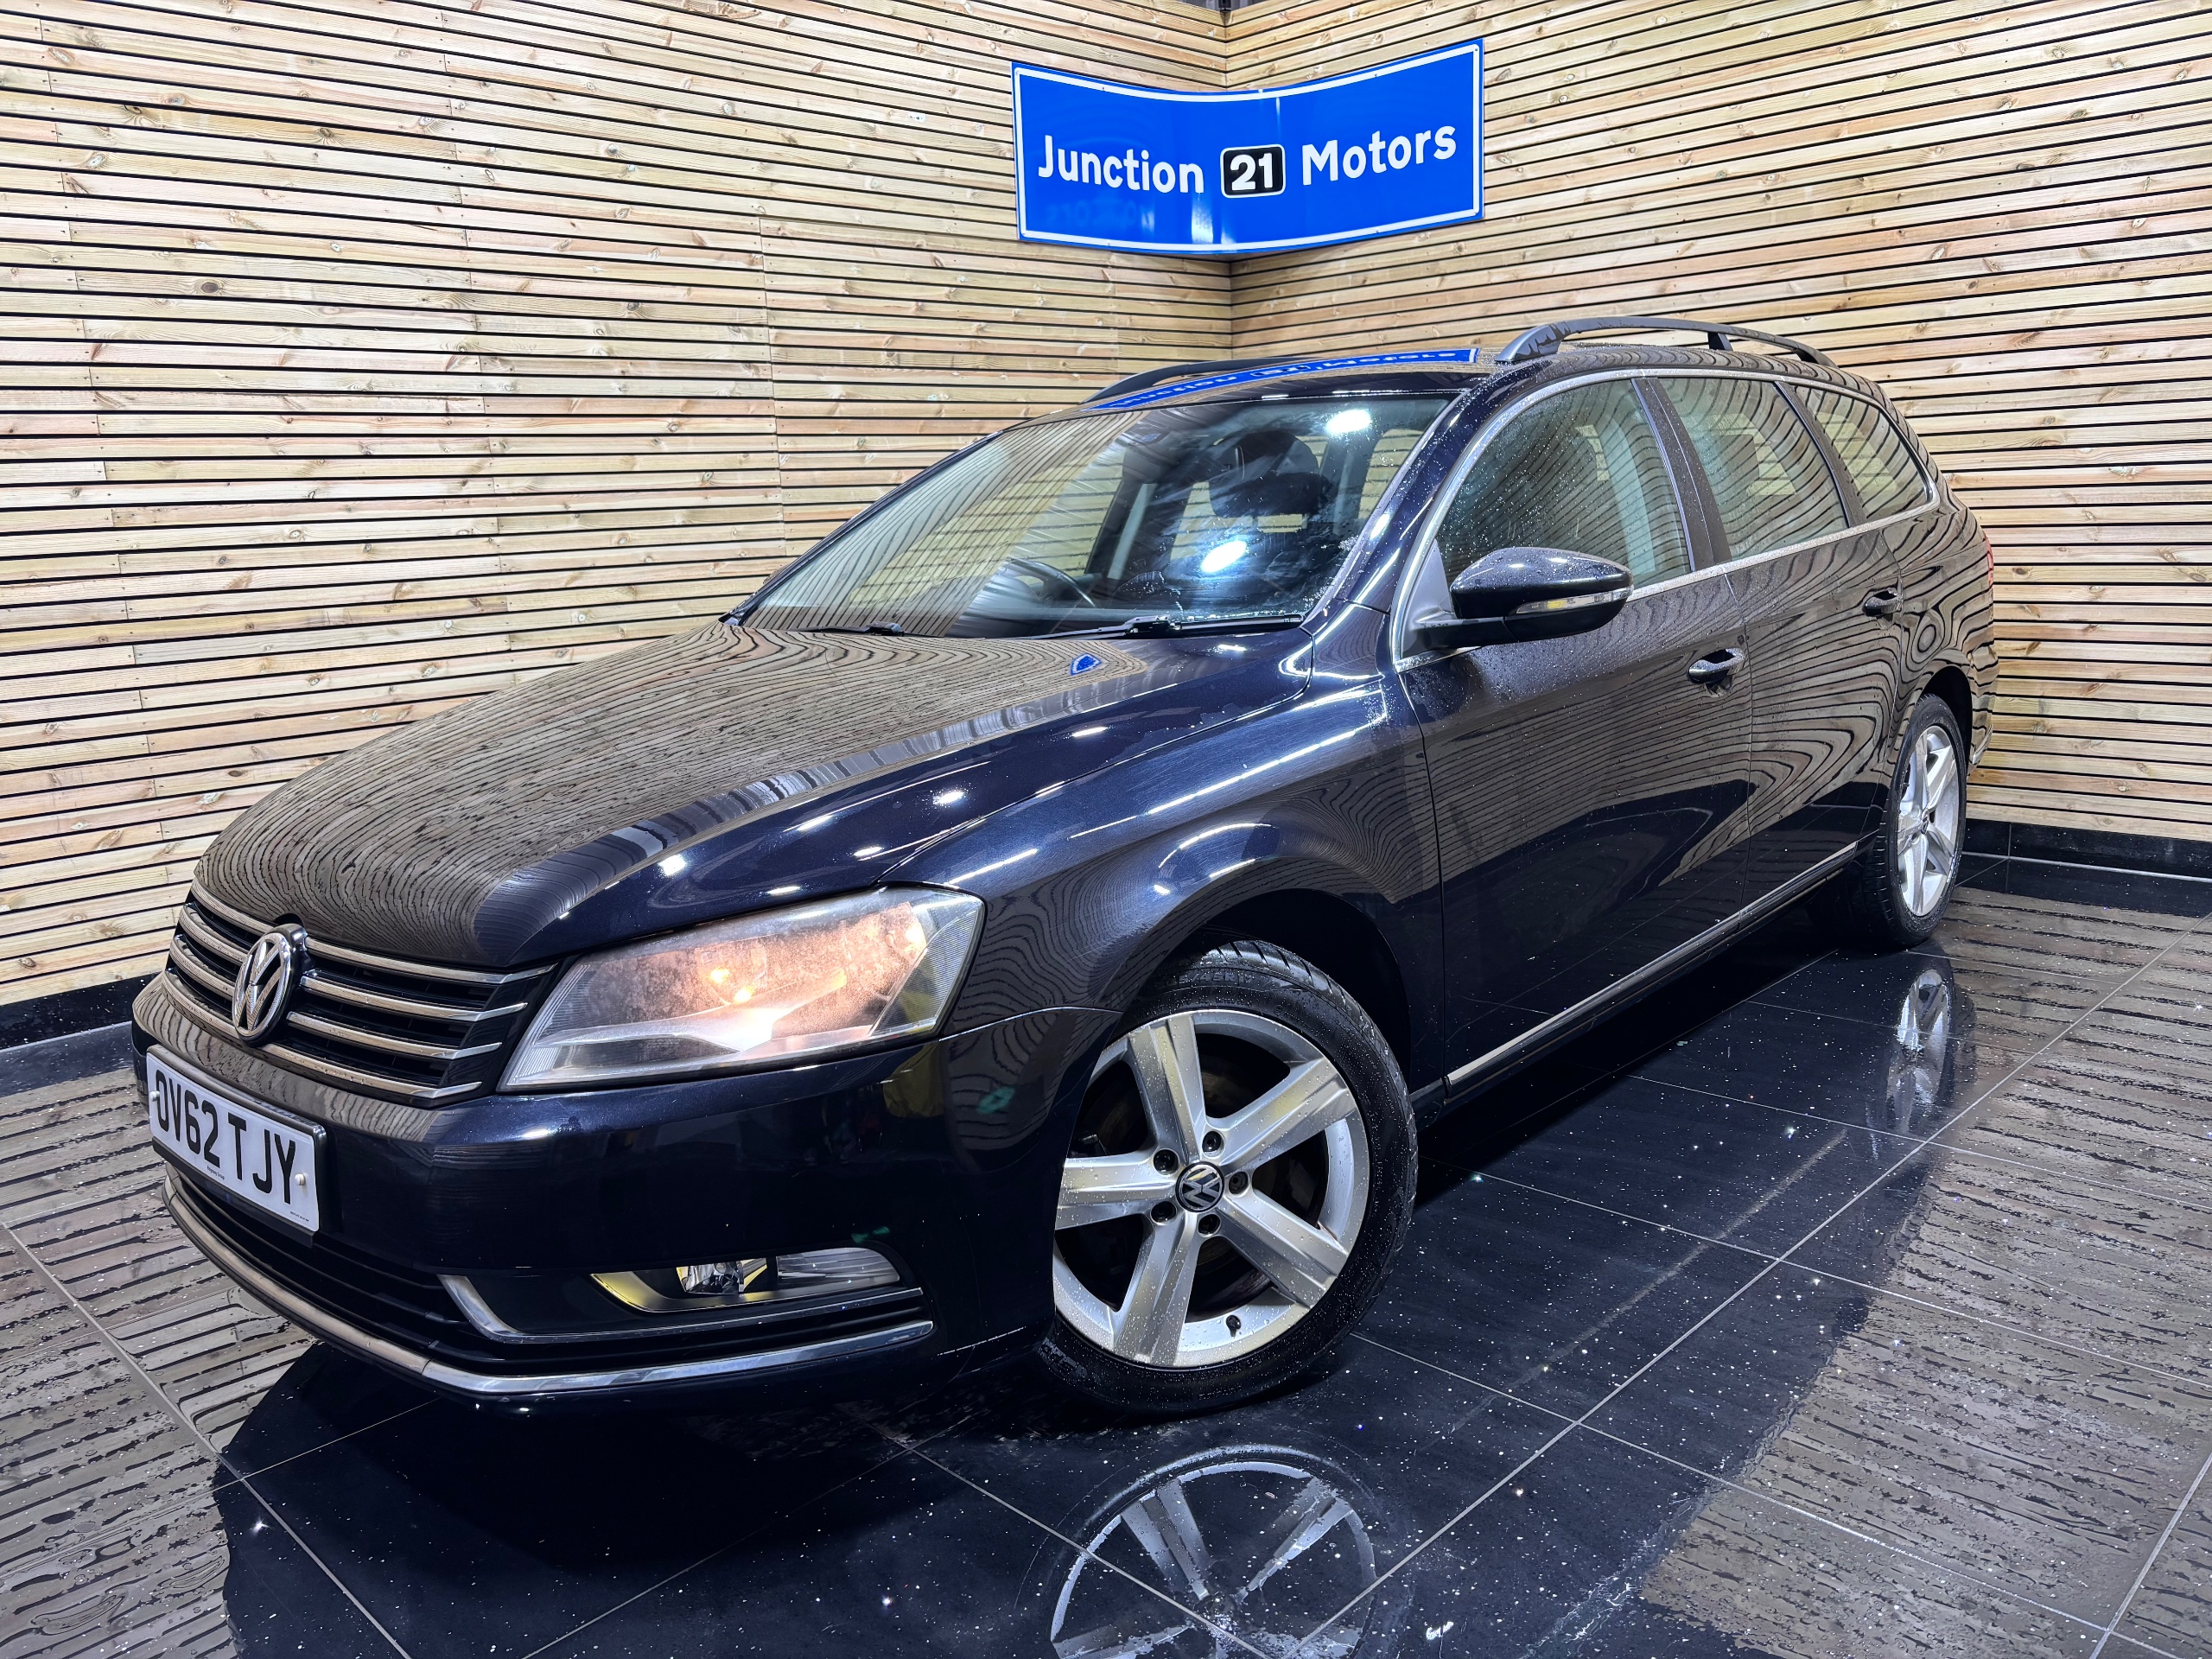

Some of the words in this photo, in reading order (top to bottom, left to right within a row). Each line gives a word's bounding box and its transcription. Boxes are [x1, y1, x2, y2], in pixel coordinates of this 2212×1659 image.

[1038, 135, 1205, 194] Junction
[1229, 152, 1274, 191] 21
[1302, 125, 1457, 186] Motors
[156, 1070, 220, 1168] OV62
[227, 1111, 296, 1205] TJY
